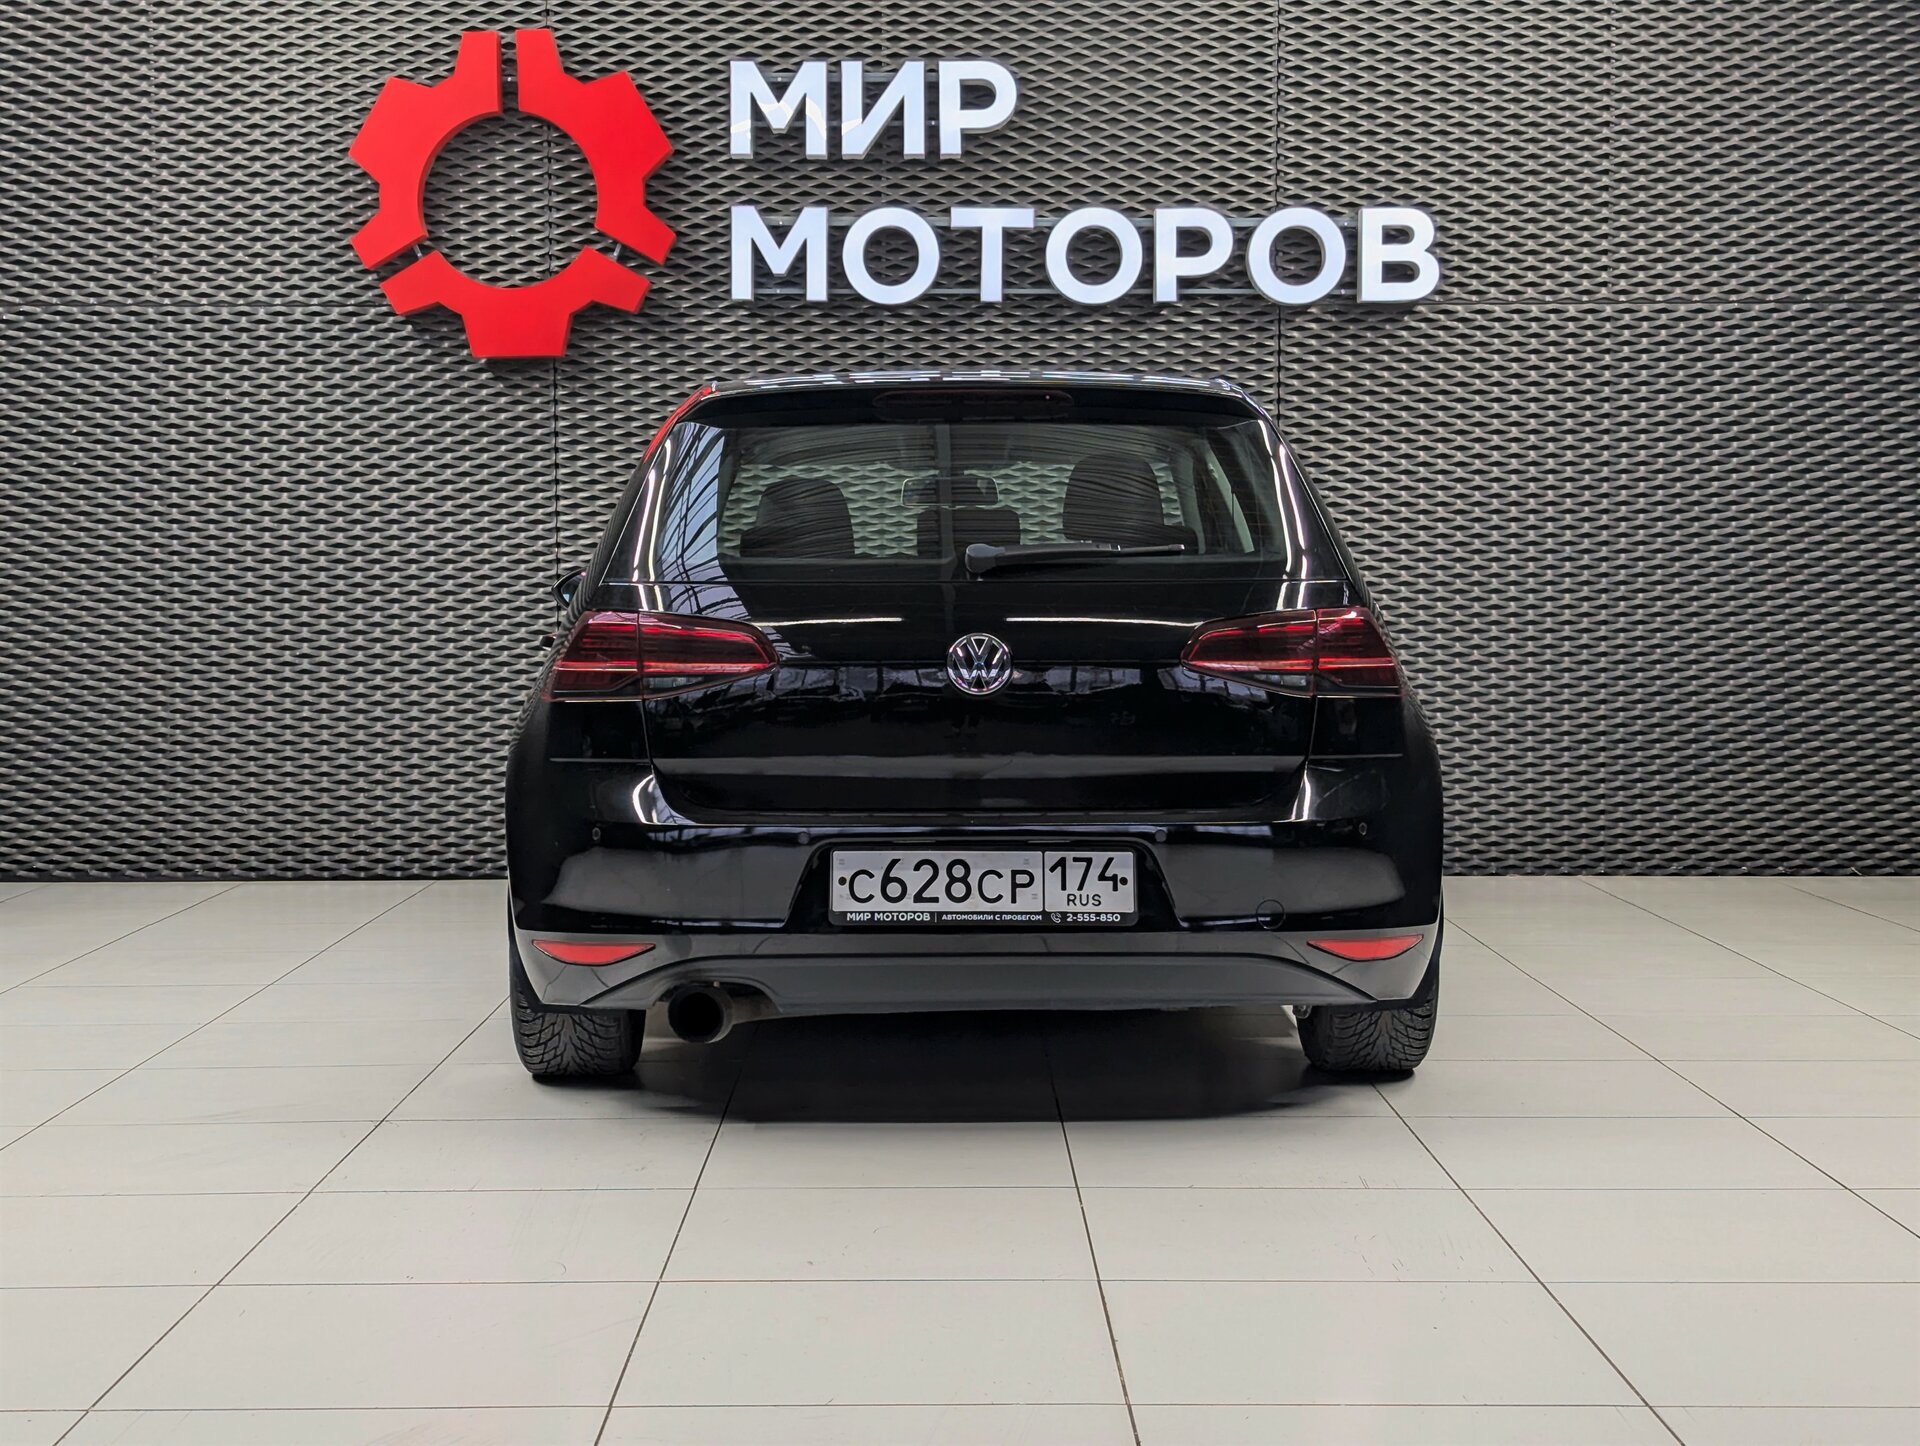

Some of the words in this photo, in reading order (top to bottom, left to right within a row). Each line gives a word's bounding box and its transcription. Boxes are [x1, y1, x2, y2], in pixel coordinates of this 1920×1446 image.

[729, 60, 1018, 159] МИР
[730, 205, 1441, 304] МОТОРОВ
[1048, 856, 1119, 892] 174
[846, 912, 872, 921] МИР
[874, 912, 931, 921] МОТОРОВ
[1066, 913, 1121, 922] 2-555-850
[1066, 893, 1102, 907] RUS
